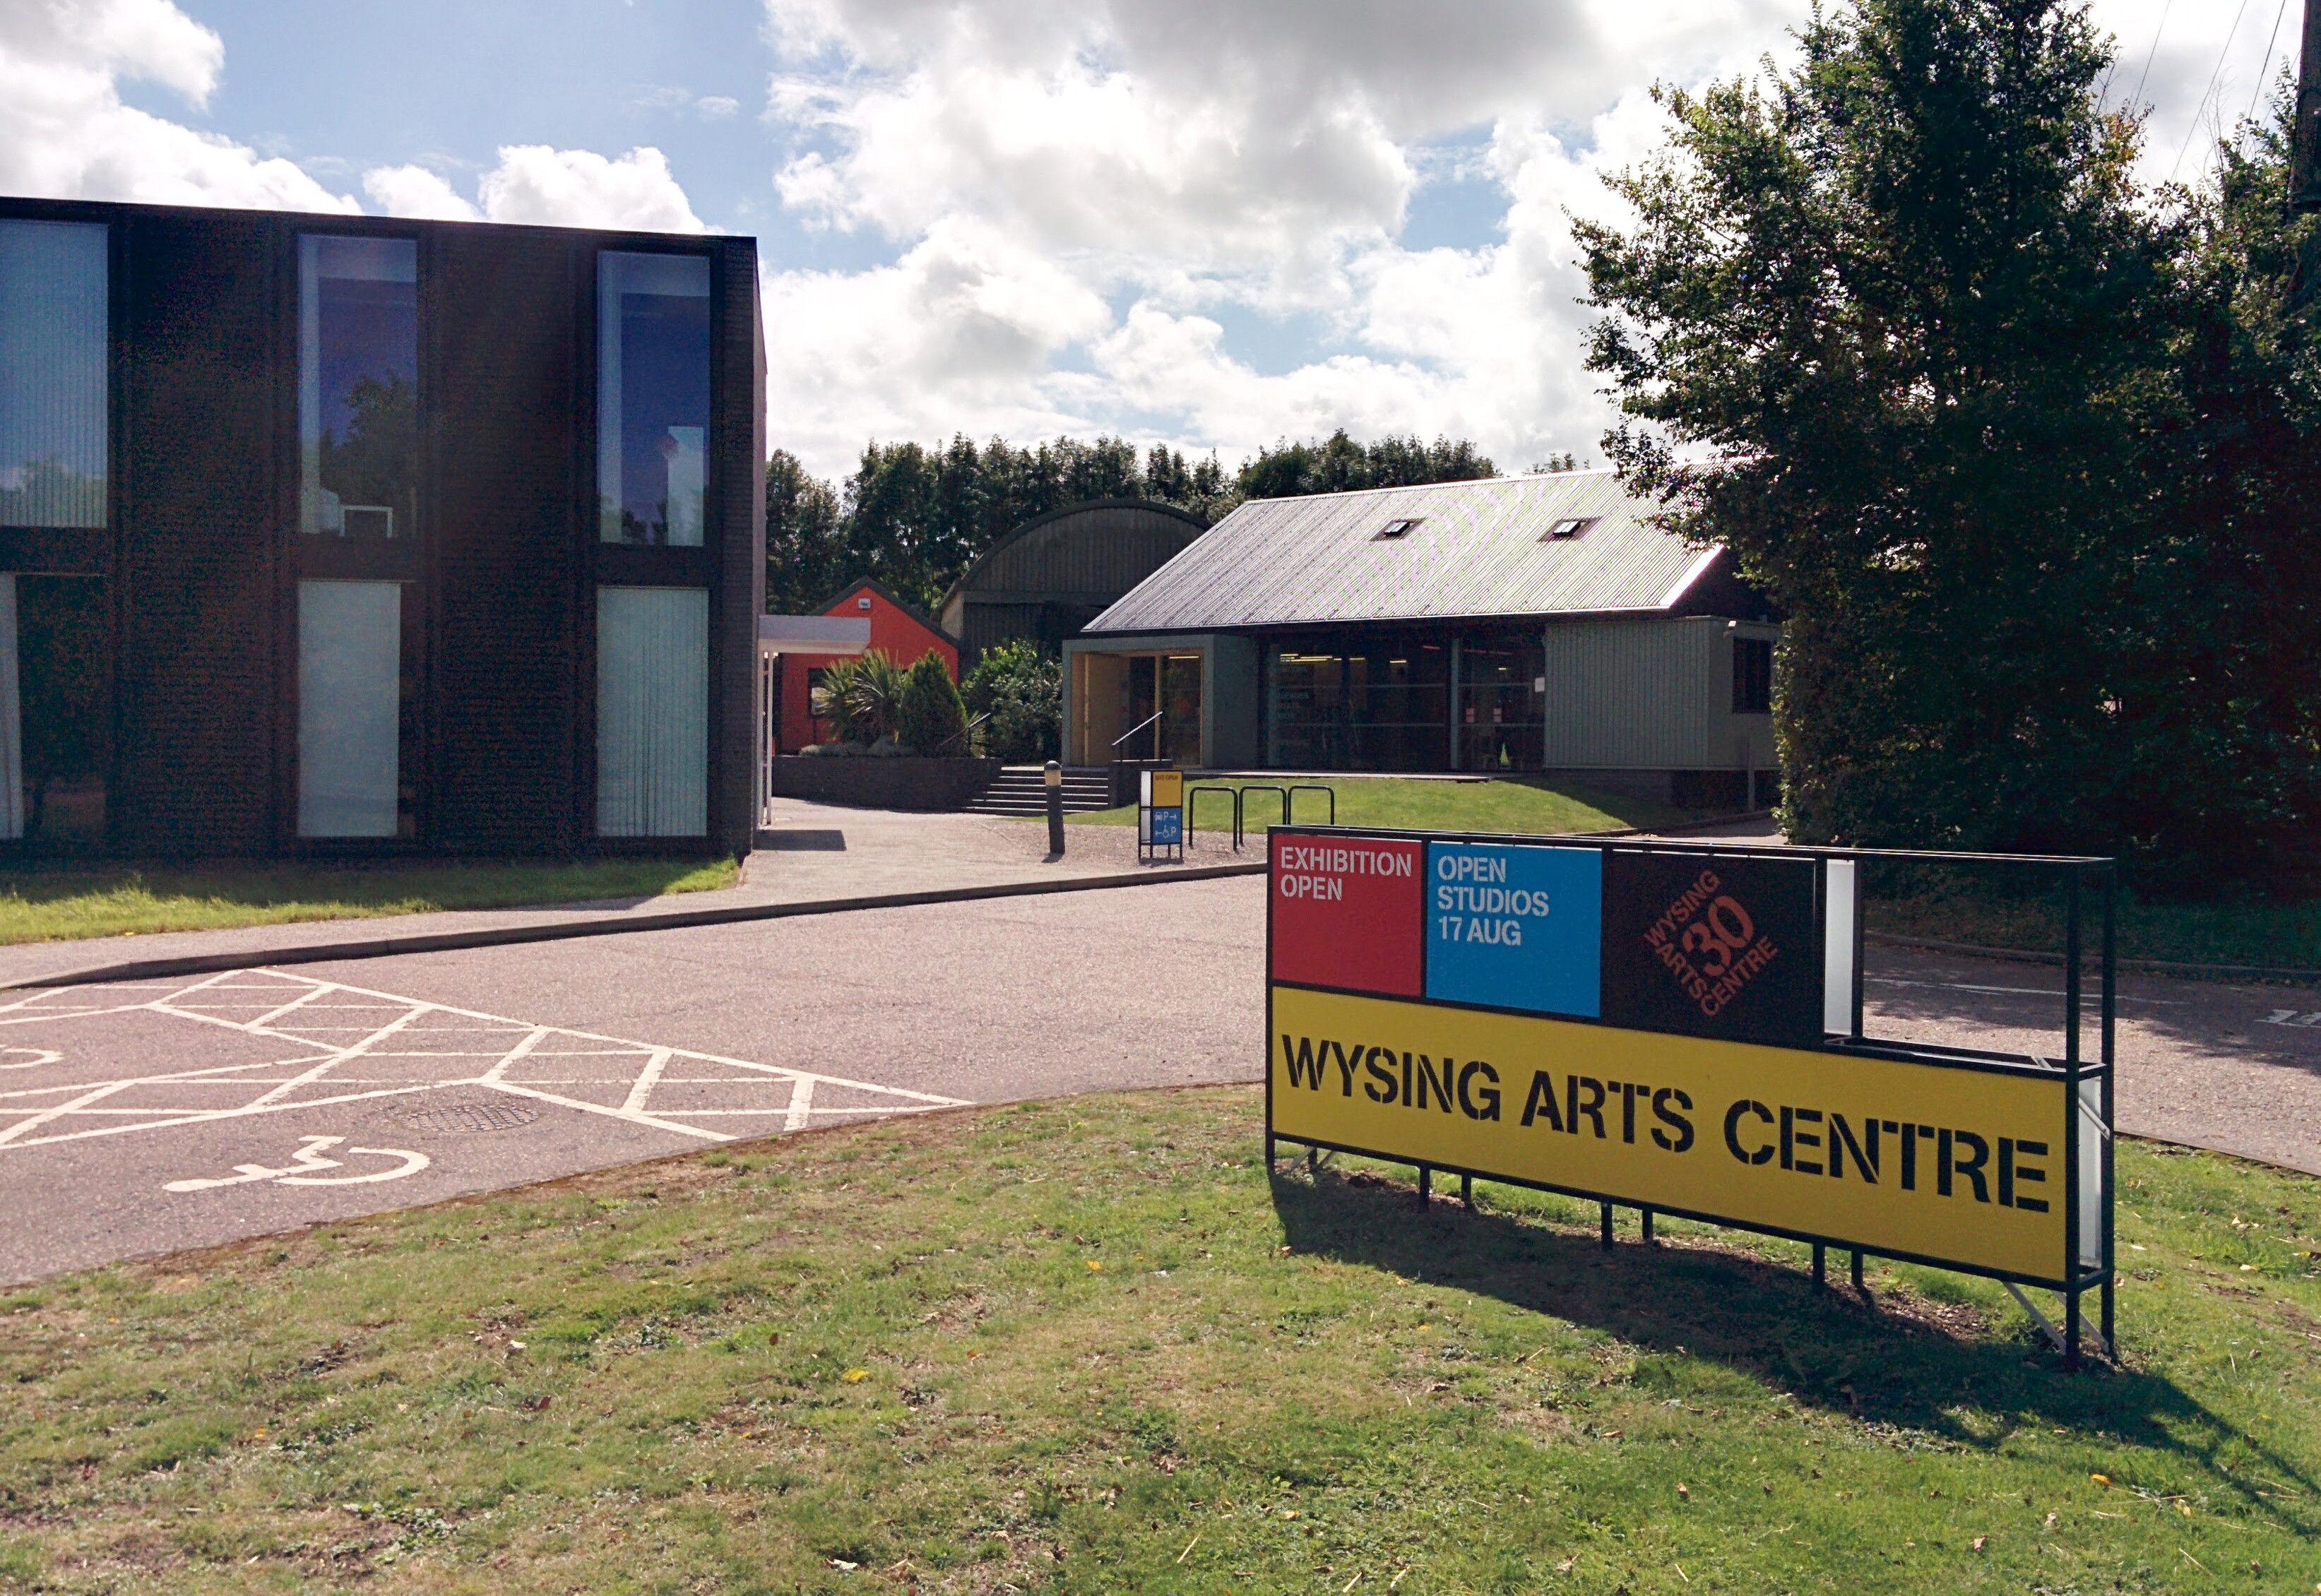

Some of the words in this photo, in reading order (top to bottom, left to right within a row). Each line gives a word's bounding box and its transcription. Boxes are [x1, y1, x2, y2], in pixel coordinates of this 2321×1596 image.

[1163, 812, 1169, 821] P
[1170, 826, 1177, 837] P
[1281, 846, 1412, 877] EXHIBITION
[1437, 855, 1507, 883] OPEN
[1281, 874, 1342, 901] OPEN
[1437, 886, 1549, 917] STUDIOS
[1643, 869, 1721, 948] WYSING
[1439, 916, 1463, 941] 17
[1466, 918, 1522, 946] AUG
[1682, 895, 1755, 977] 30
[1655, 943, 1709, 999] ARTS
[1699, 935, 1779, 1016] CENTRE
[1282, 1034, 1500, 1122] WYSING
[1521, 1070, 1695, 1153] ARTS
[1723, 1099, 2050, 1213] CENTRE
